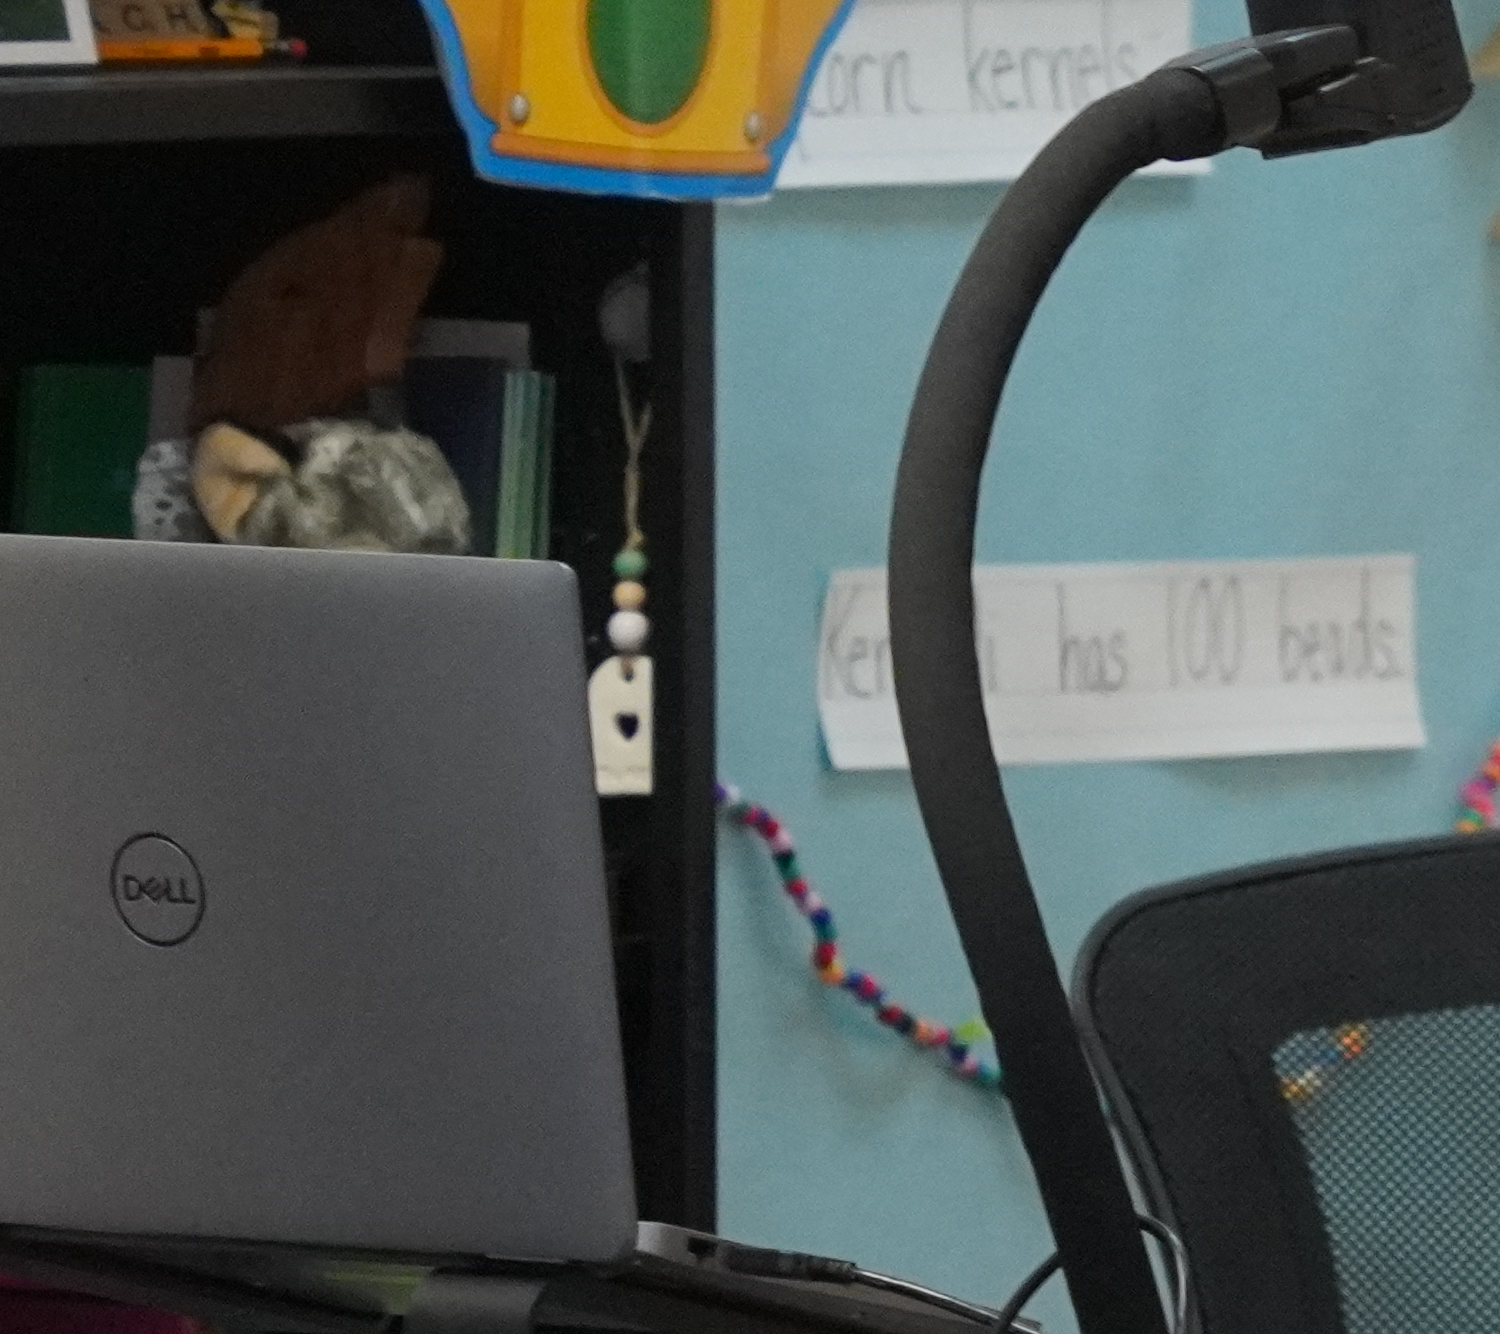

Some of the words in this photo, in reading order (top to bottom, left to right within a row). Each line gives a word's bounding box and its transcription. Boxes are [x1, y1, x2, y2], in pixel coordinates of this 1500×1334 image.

[1055, 581, 1130, 695] has
[1167, 576, 1247, 687] 100
[122, 874, 196, 905] DELL
